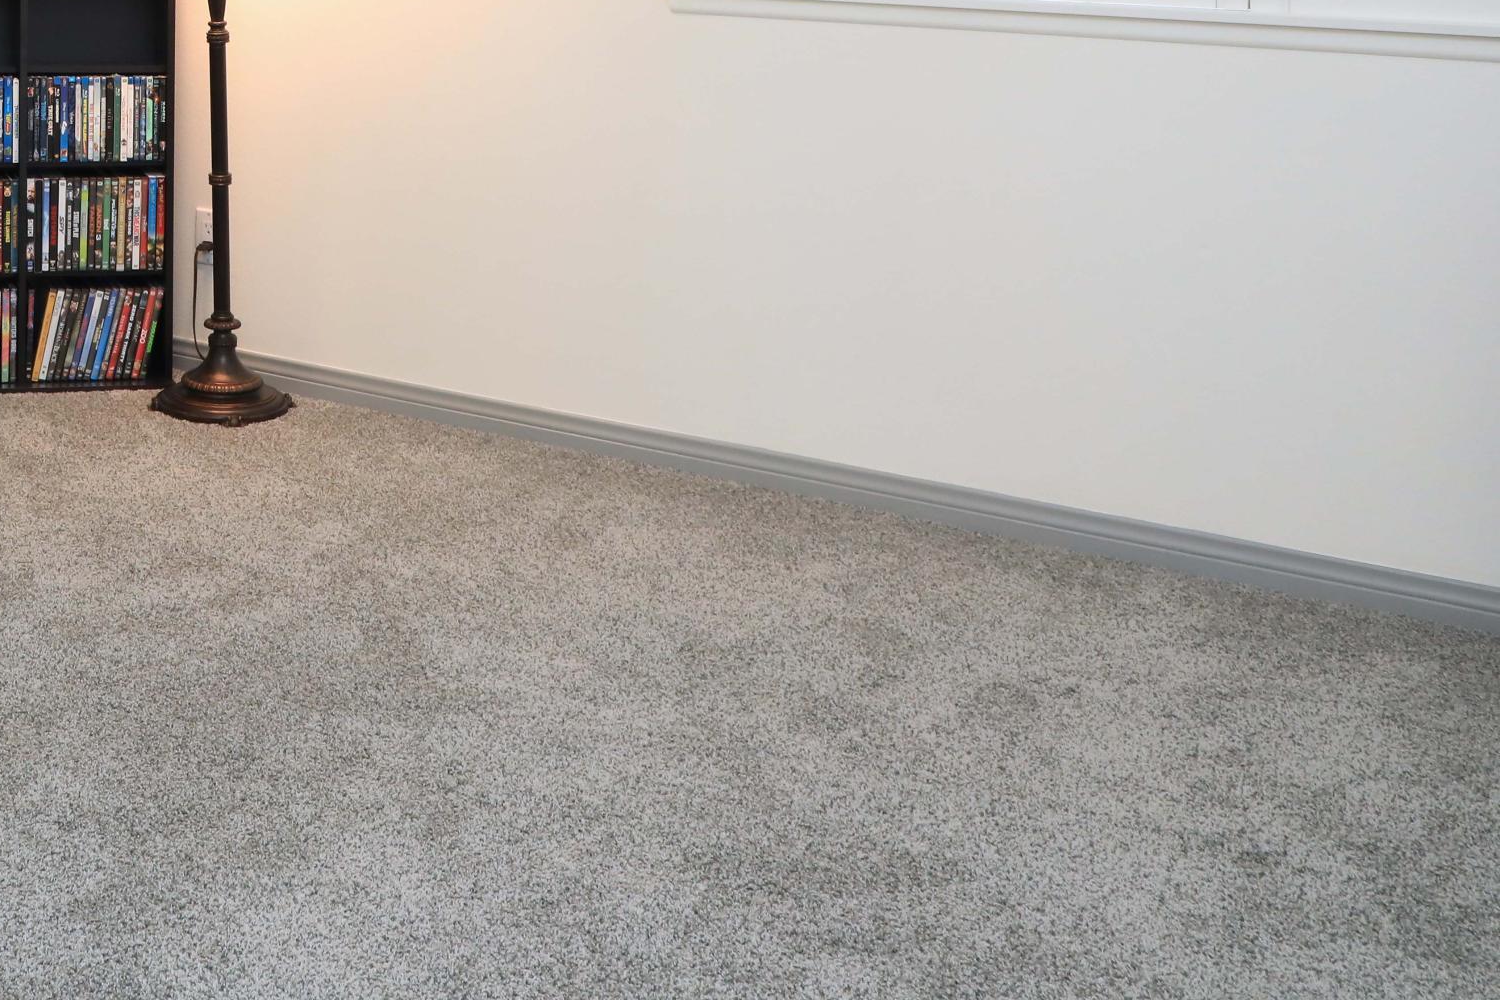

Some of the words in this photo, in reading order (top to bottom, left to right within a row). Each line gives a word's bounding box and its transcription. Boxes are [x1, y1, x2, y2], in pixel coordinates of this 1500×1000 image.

[129, 304, 137, 321] ZERO
[124, 322, 133, 340] DARK
[139, 328, 148, 344] ZOO
[119, 341, 128, 363] THIRTY
